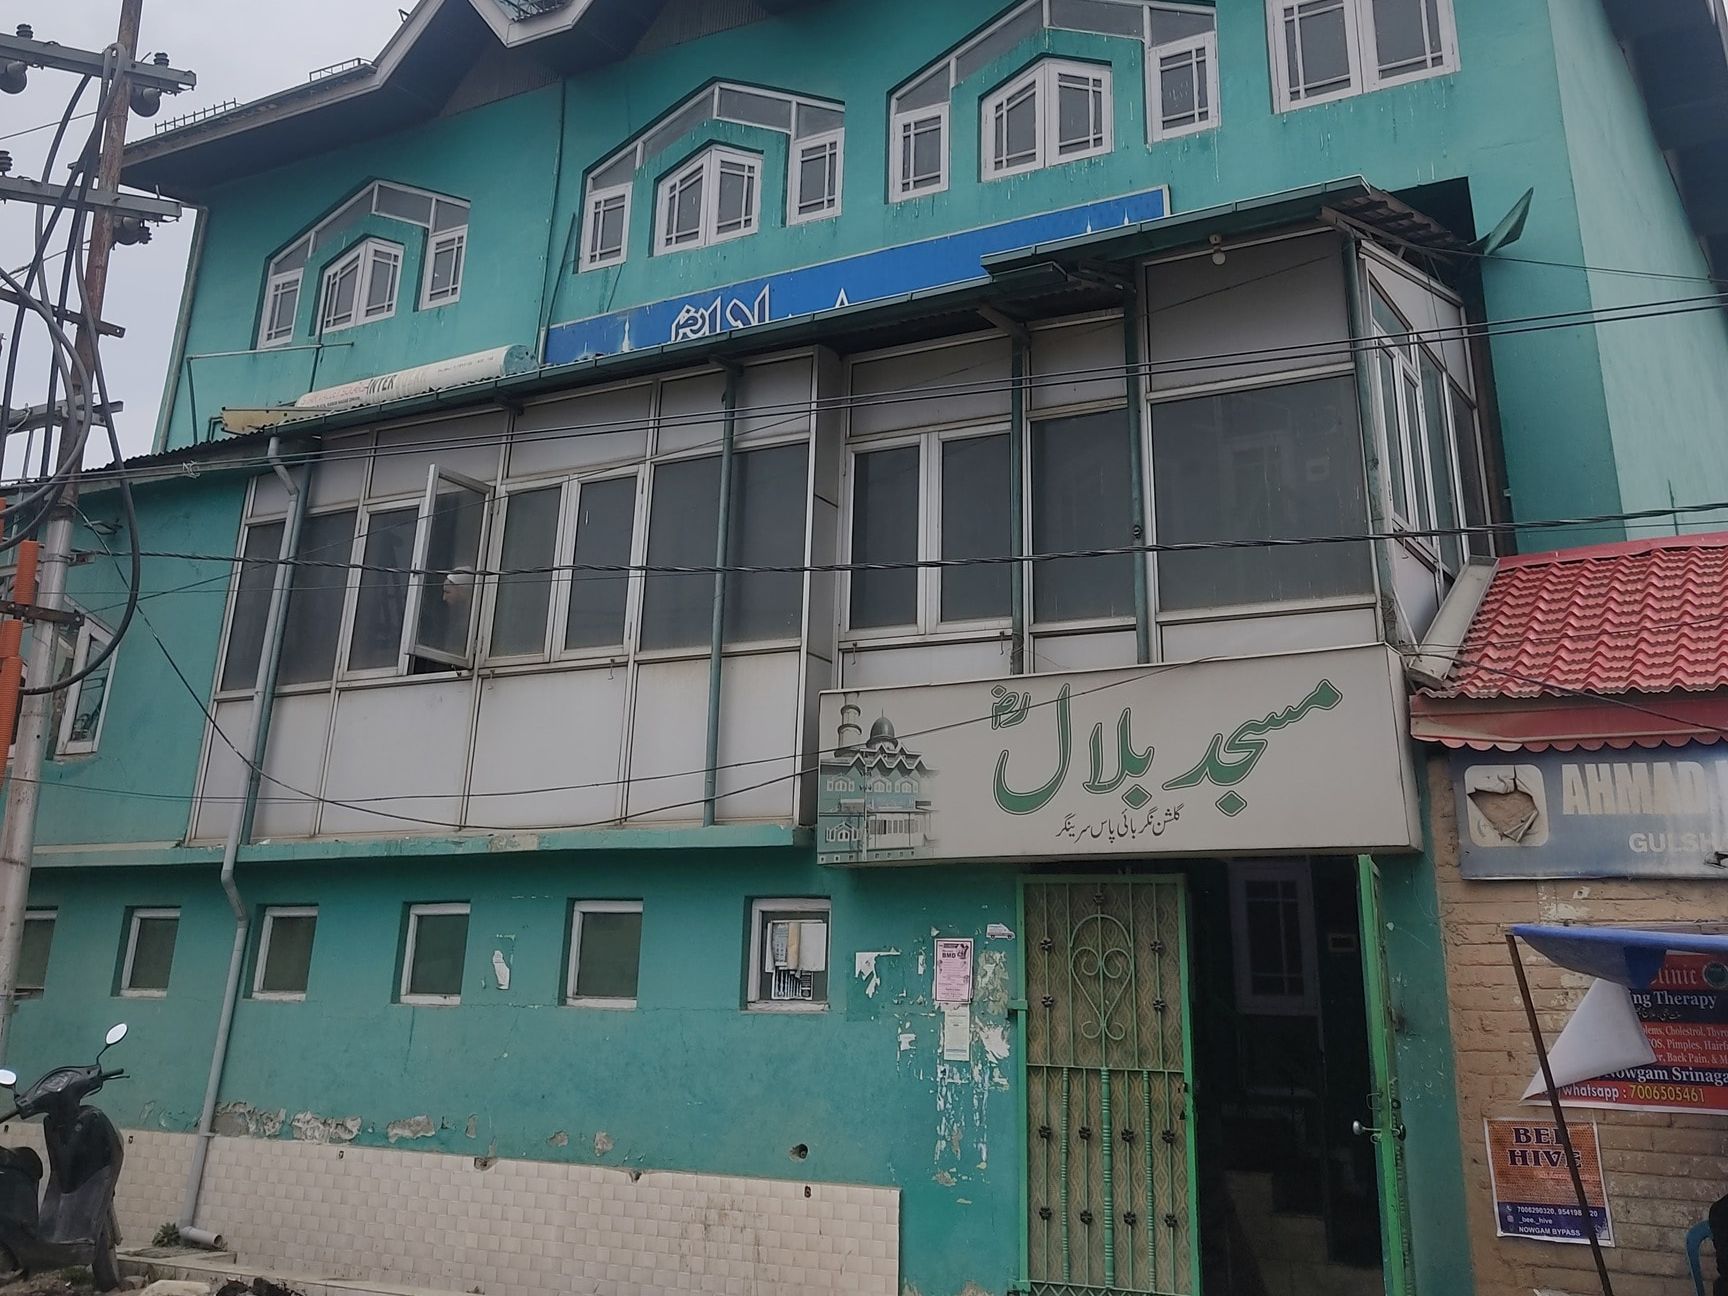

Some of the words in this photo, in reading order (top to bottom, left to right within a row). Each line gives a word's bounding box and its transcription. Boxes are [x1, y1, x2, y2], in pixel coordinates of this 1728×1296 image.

[993, 683, 1155, 815] بلال
[1161, 679, 1344, 817] مسجد
[1561, 761, 1710, 815] AHMAD
[1138, 806, 1158, 834] نگر
[1152, 803, 1185, 836] گلشن
[1650, 964, 1697, 985] linic
[1653, 990, 1718, 1009] Therapy
[1667, 1052, 1687, 1063] Back
[1629, 1084, 1705, 1102] 7006505461
[1518, 1226, 1551, 1235] NOWGAM
[1552, 1227, 1581, 1236] BYPASS
